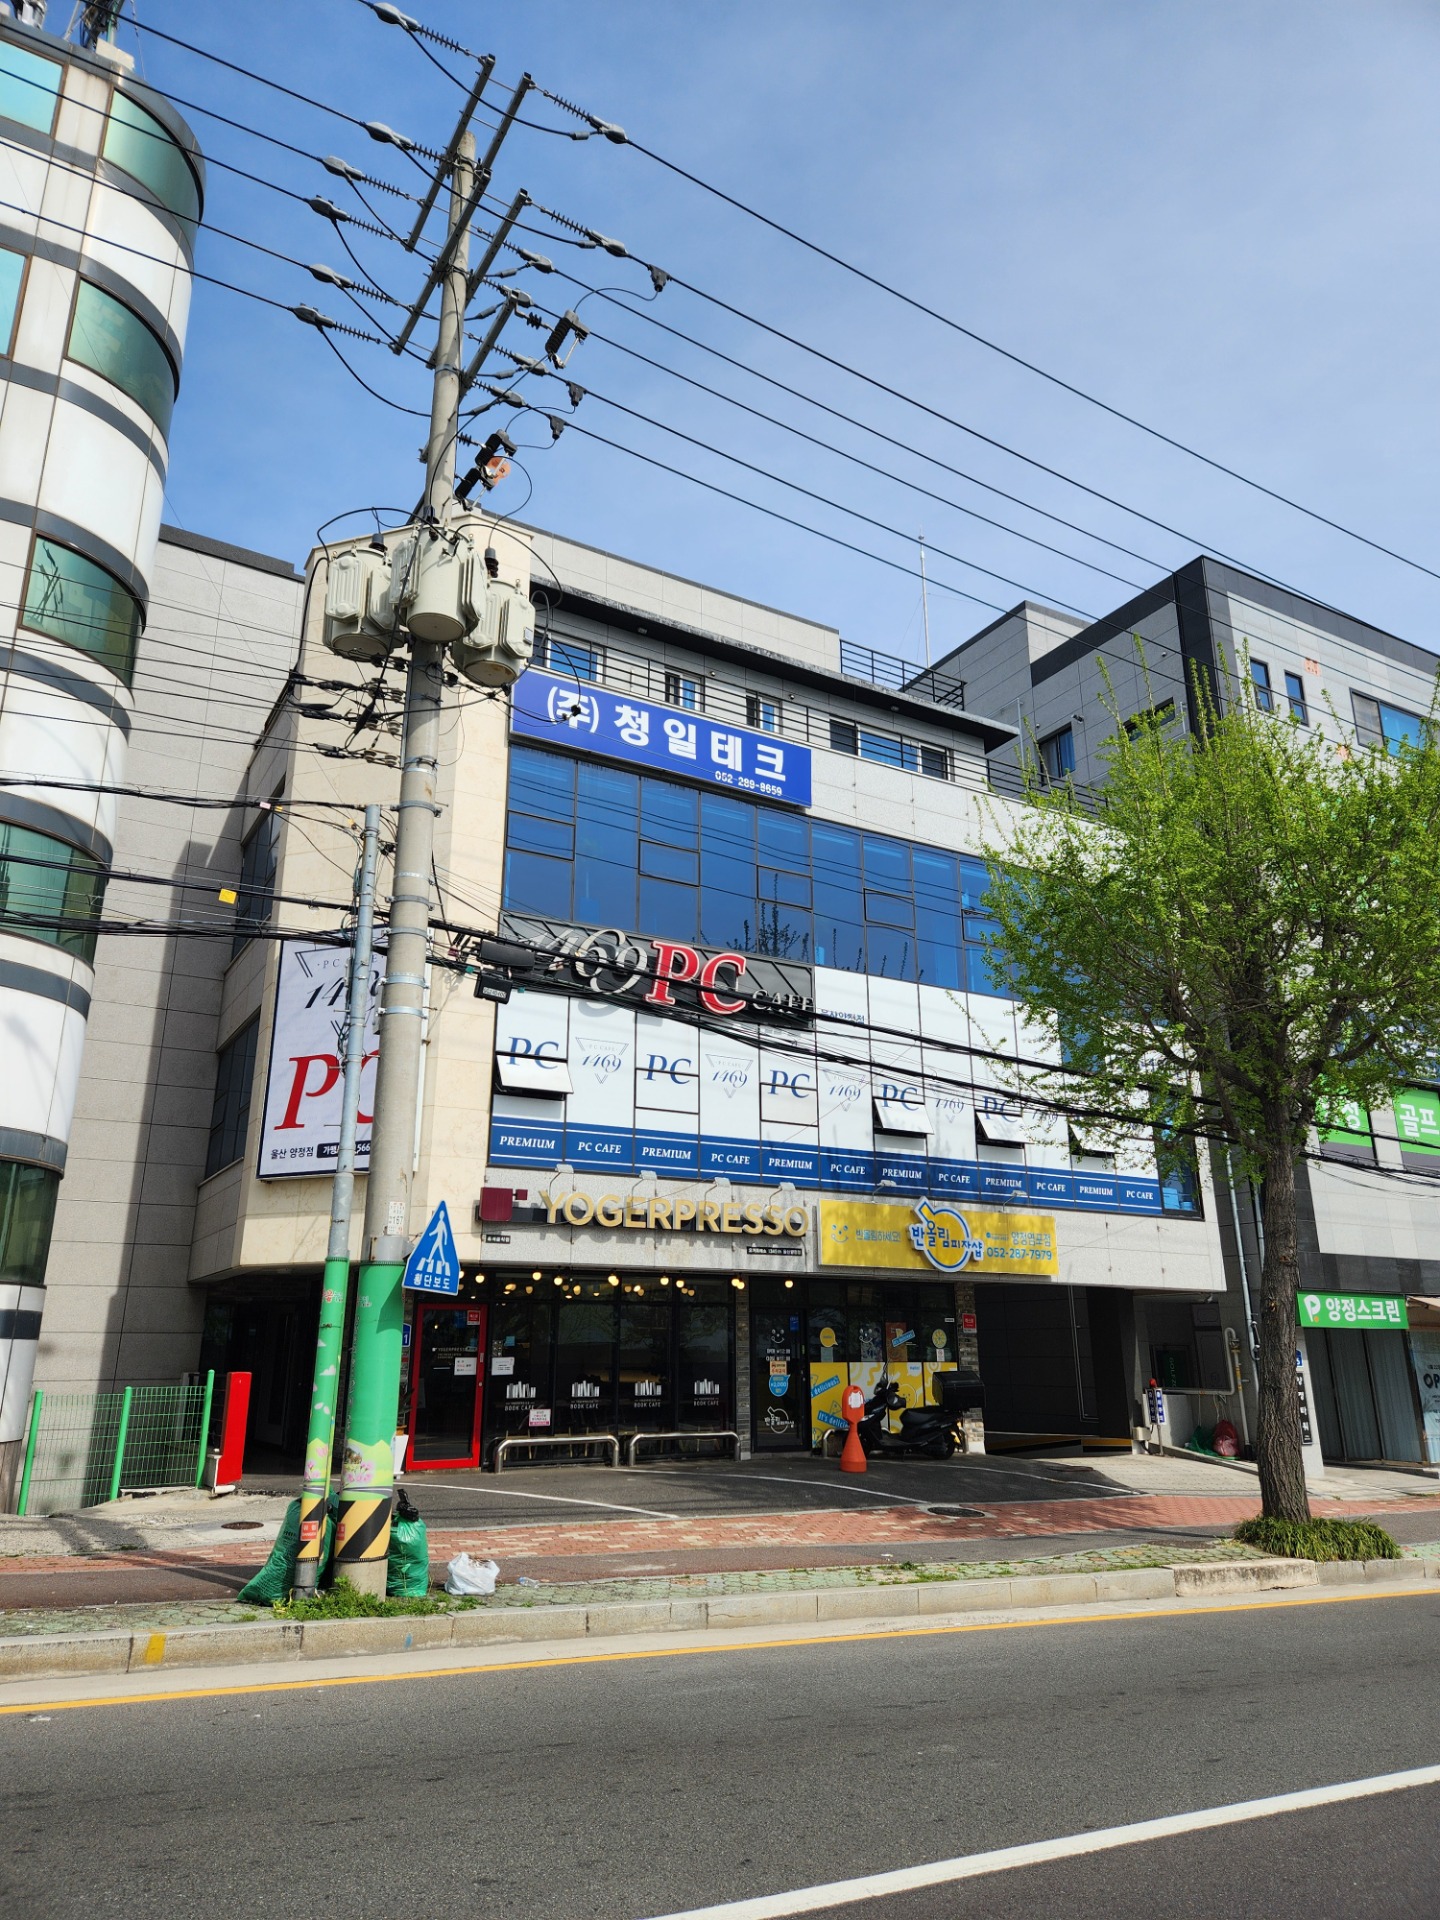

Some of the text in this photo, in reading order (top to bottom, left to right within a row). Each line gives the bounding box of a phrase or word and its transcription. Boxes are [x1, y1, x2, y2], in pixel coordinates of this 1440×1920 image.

[547, 686, 786, 782] (주) 청일테크
[644, 940, 747, 1015] PC
[506, 1036, 559, 1070] PC
[581, 1053, 622, 1074] 1469
[643, 1053, 692, 1085] PC
[712, 1069, 748, 1089] 1469
[767, 1069, 811, 1099] PC
[880, 1083, 920, 1112] PC
[1399, 1103, 1440, 1138] 골프
[499, 1136, 556, 1150] PREMIUM
[578, 1141, 622, 1154] PC CAFE
[641, 1146, 692, 1160] PREMIUM
[711, 1153, 750, 1165] PC CAFE
[768, 1158, 813, 1170] PREMIUM
[830, 1163, 866, 1175] PC CAFE
[882, 1168, 923, 1180] PREMIUM
[938, 1173, 971, 1184] PC CAFE
[985, 1177, 1022, 1188] PREMIUM
[1036, 1182, 1067, 1193] PC CAFE
[1079, 1185, 1113, 1196] PREMIUM
[1126, 1190, 1154, 1200] PC CAFE
[538, 1190, 810, 1238] YOGERPRESSO
[986, 1246, 1053, 1261] 052-287-7979
[413, 1272, 450, 1291] 횡단보도
[1325, 1297, 1402, 1323] 양정스크린
